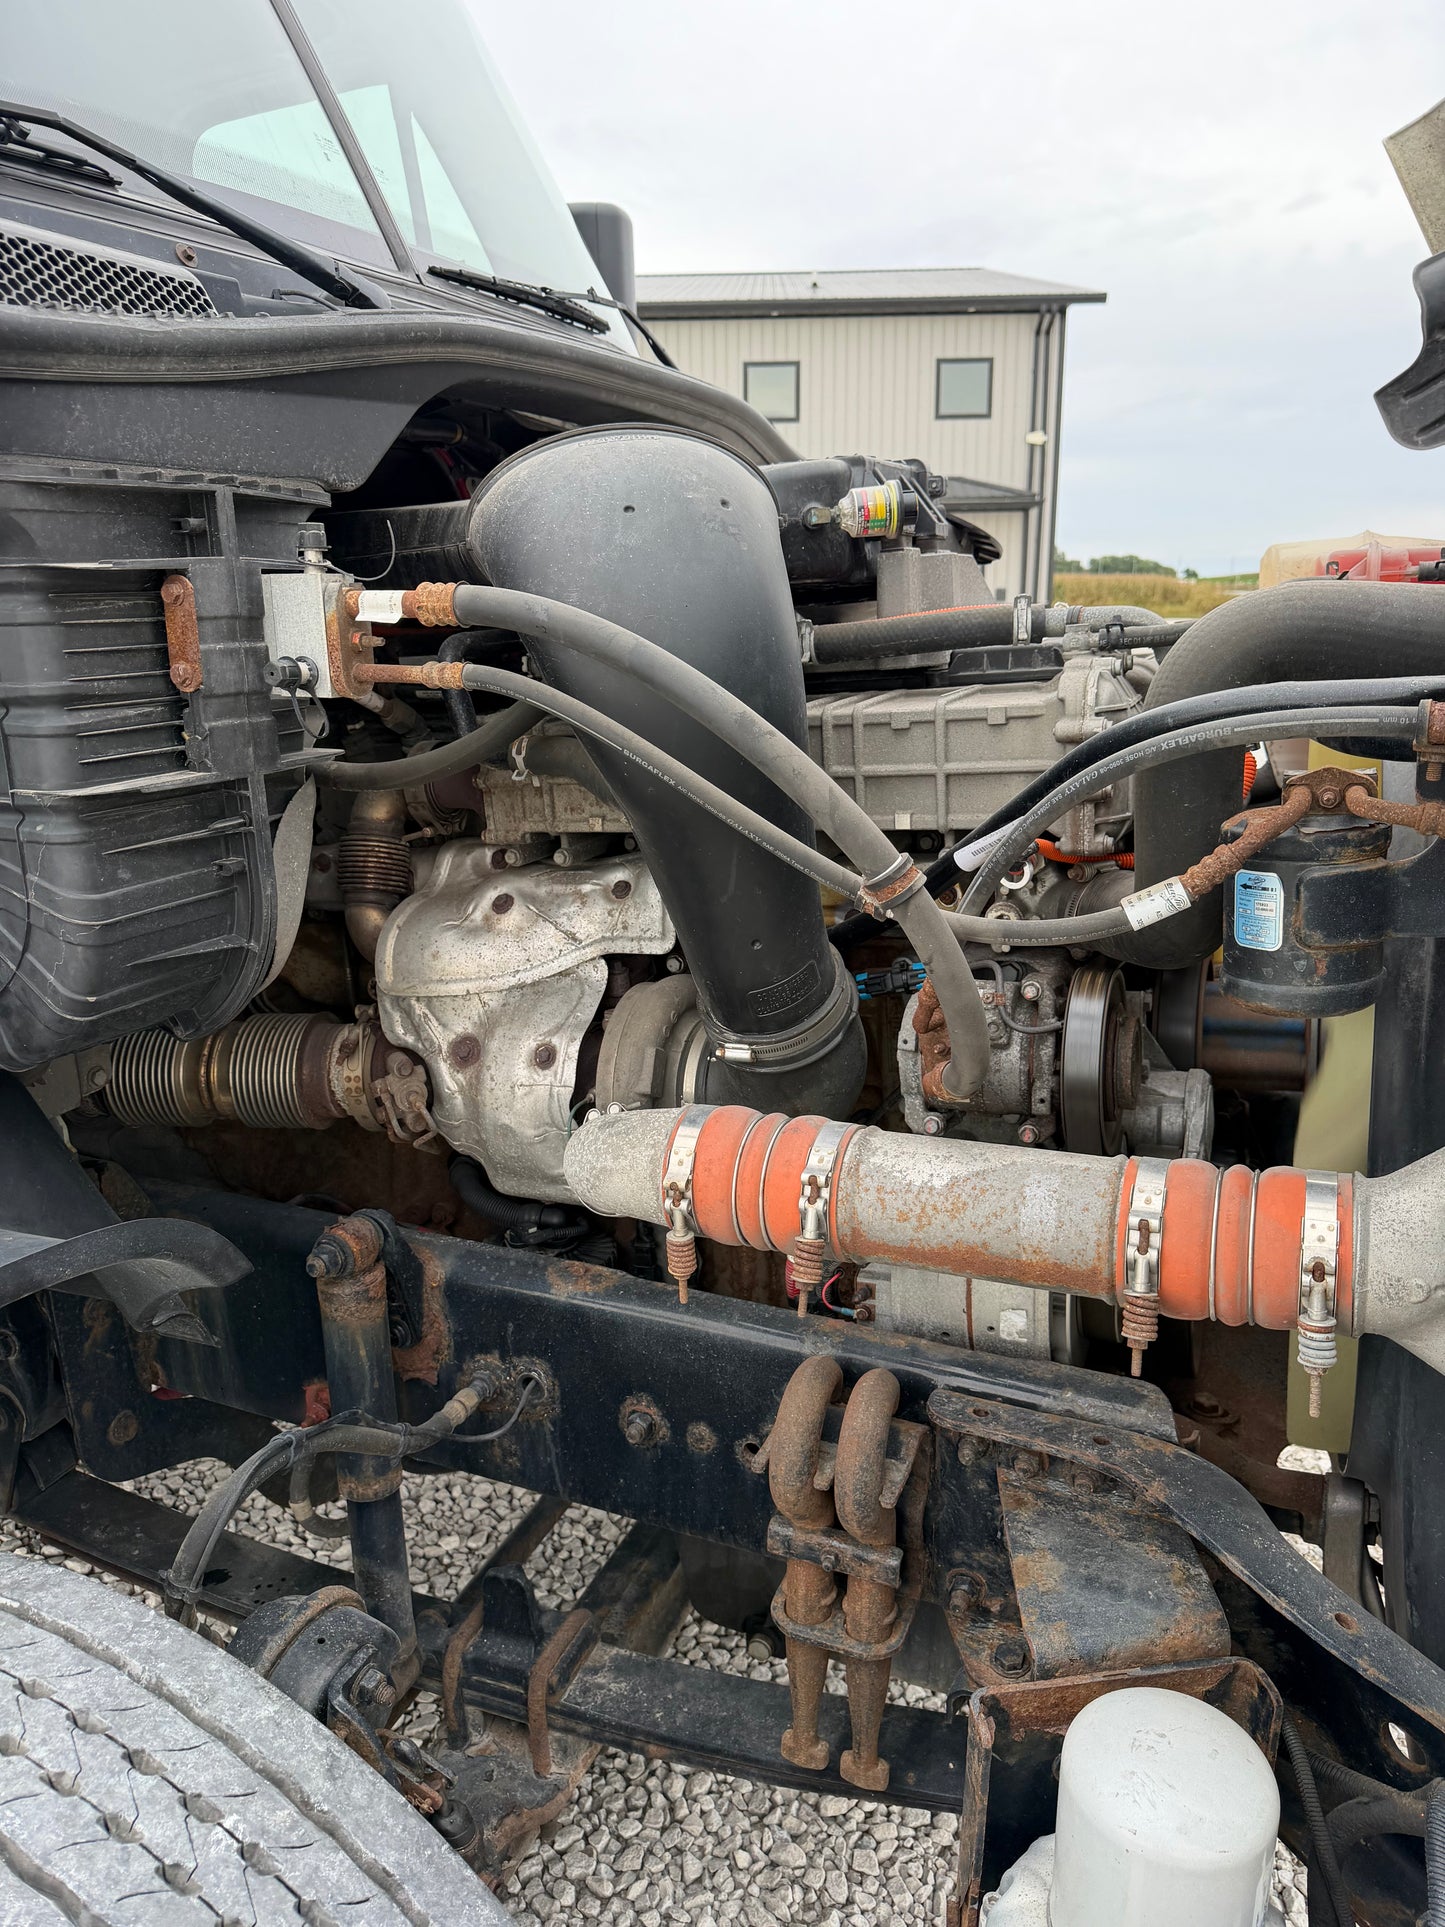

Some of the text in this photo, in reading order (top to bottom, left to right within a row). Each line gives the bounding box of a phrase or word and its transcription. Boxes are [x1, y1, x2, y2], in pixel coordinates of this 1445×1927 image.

[1158, 726, 1232, 750] BURGAFLEX
[1124, 750, 1144, 762] HOSE
[1143, 745, 1157, 754] A/C
[1061, 770, 1098, 796] GALAXY
[1050, 792, 1062, 804] SAE
[622, 747, 676, 788] BURGAFLEX
[687, 792, 704, 805] HOSE
[725, 818, 762, 842] GALAXY
[761, 841, 774, 851] SAE
[773, 848, 791, 861] J2064
[789, 859, 804, 870] Type
[1035, 800, 1052, 816] J2064
[1024, 812, 1037, 825] Type
[1010, 826, 1023, 840] Class
